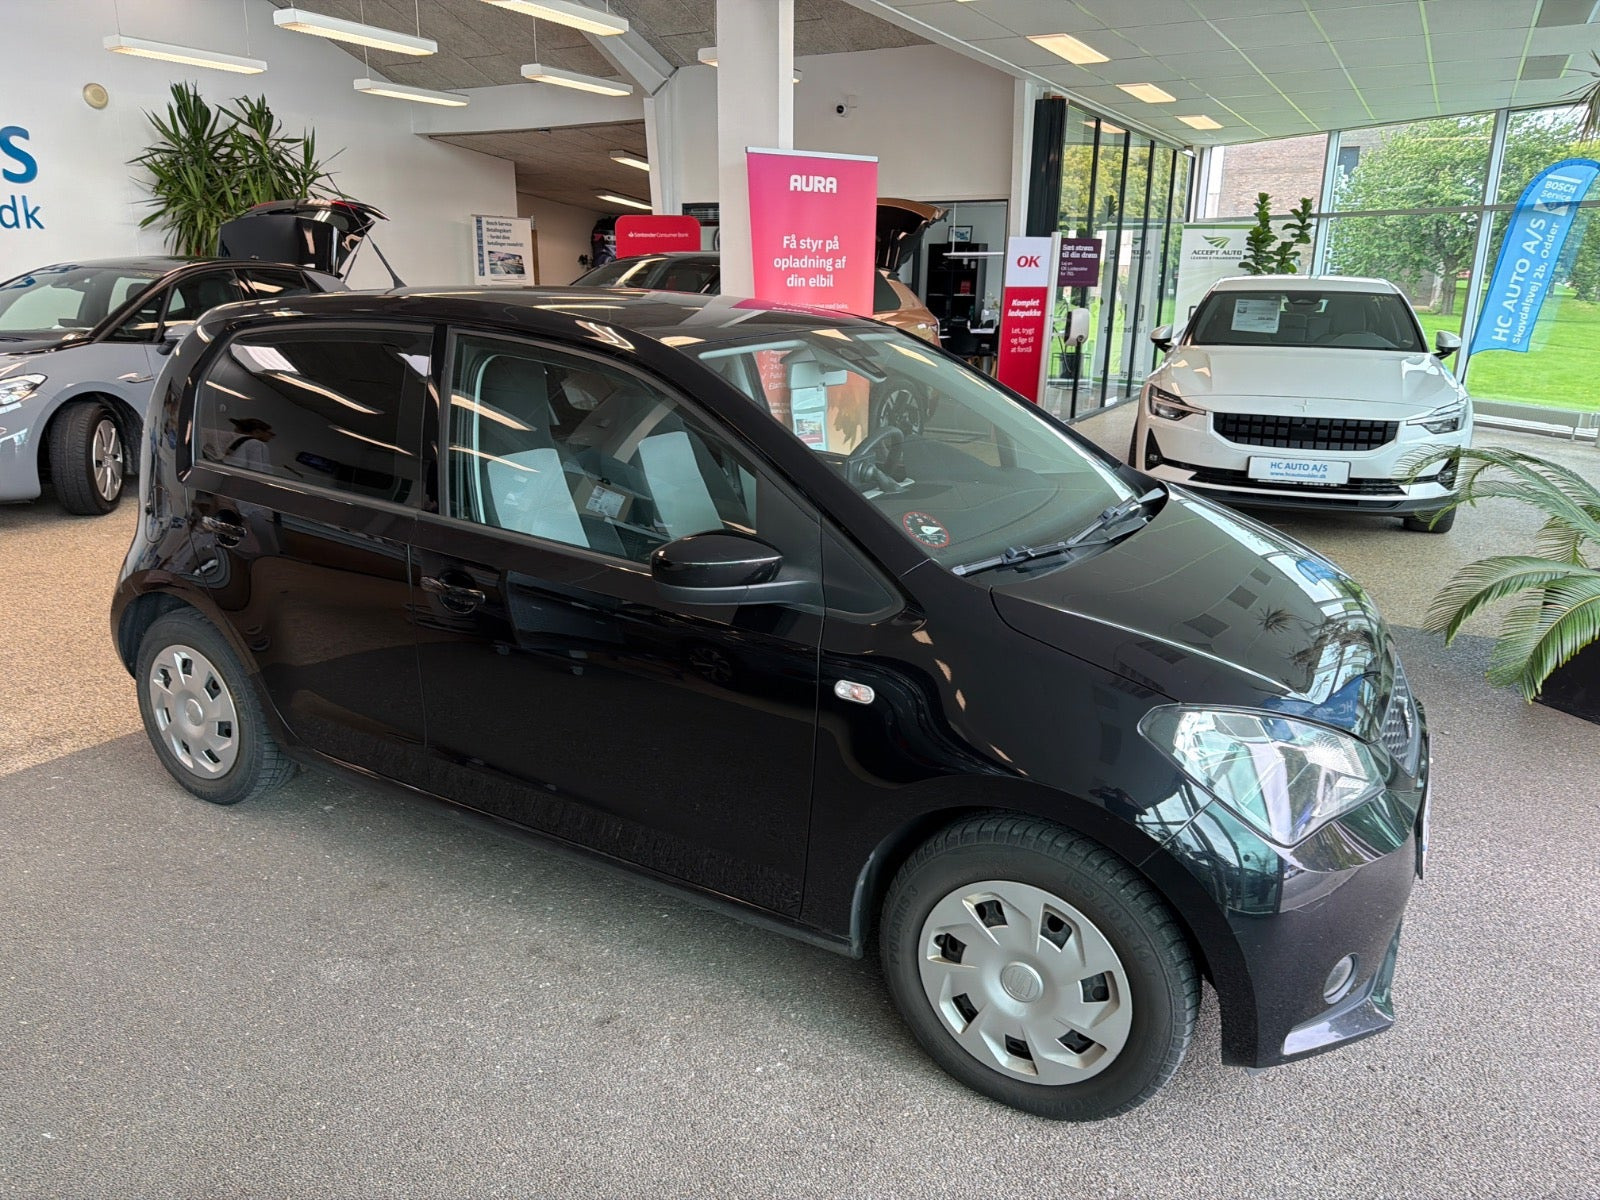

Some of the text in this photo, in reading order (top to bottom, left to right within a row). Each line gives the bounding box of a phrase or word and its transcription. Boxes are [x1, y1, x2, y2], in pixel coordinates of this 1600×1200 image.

[790, 174, 837, 194] AURA
[1544, 180, 1577, 194] BOSCH
[1541, 190, 1572, 202] Service
[783, 234, 839, 252] Få styr på
[774, 255, 846, 272] opladning af
[1017, 256, 1041, 268] OK
[786, 274, 833, 287] din elbil
[1492, 218, 1546, 342] HC AUTO A/S
[1512, 281, 1542, 344] Skovdalsvej
[1540, 222, 1560, 258] Odder
[1012, 299, 1040, 308] Komplet
[1008, 309, 1041, 318] ladepakke
[1284, 462, 1309, 471] AUTO
[1311, 464, 1328, 472] A/S
